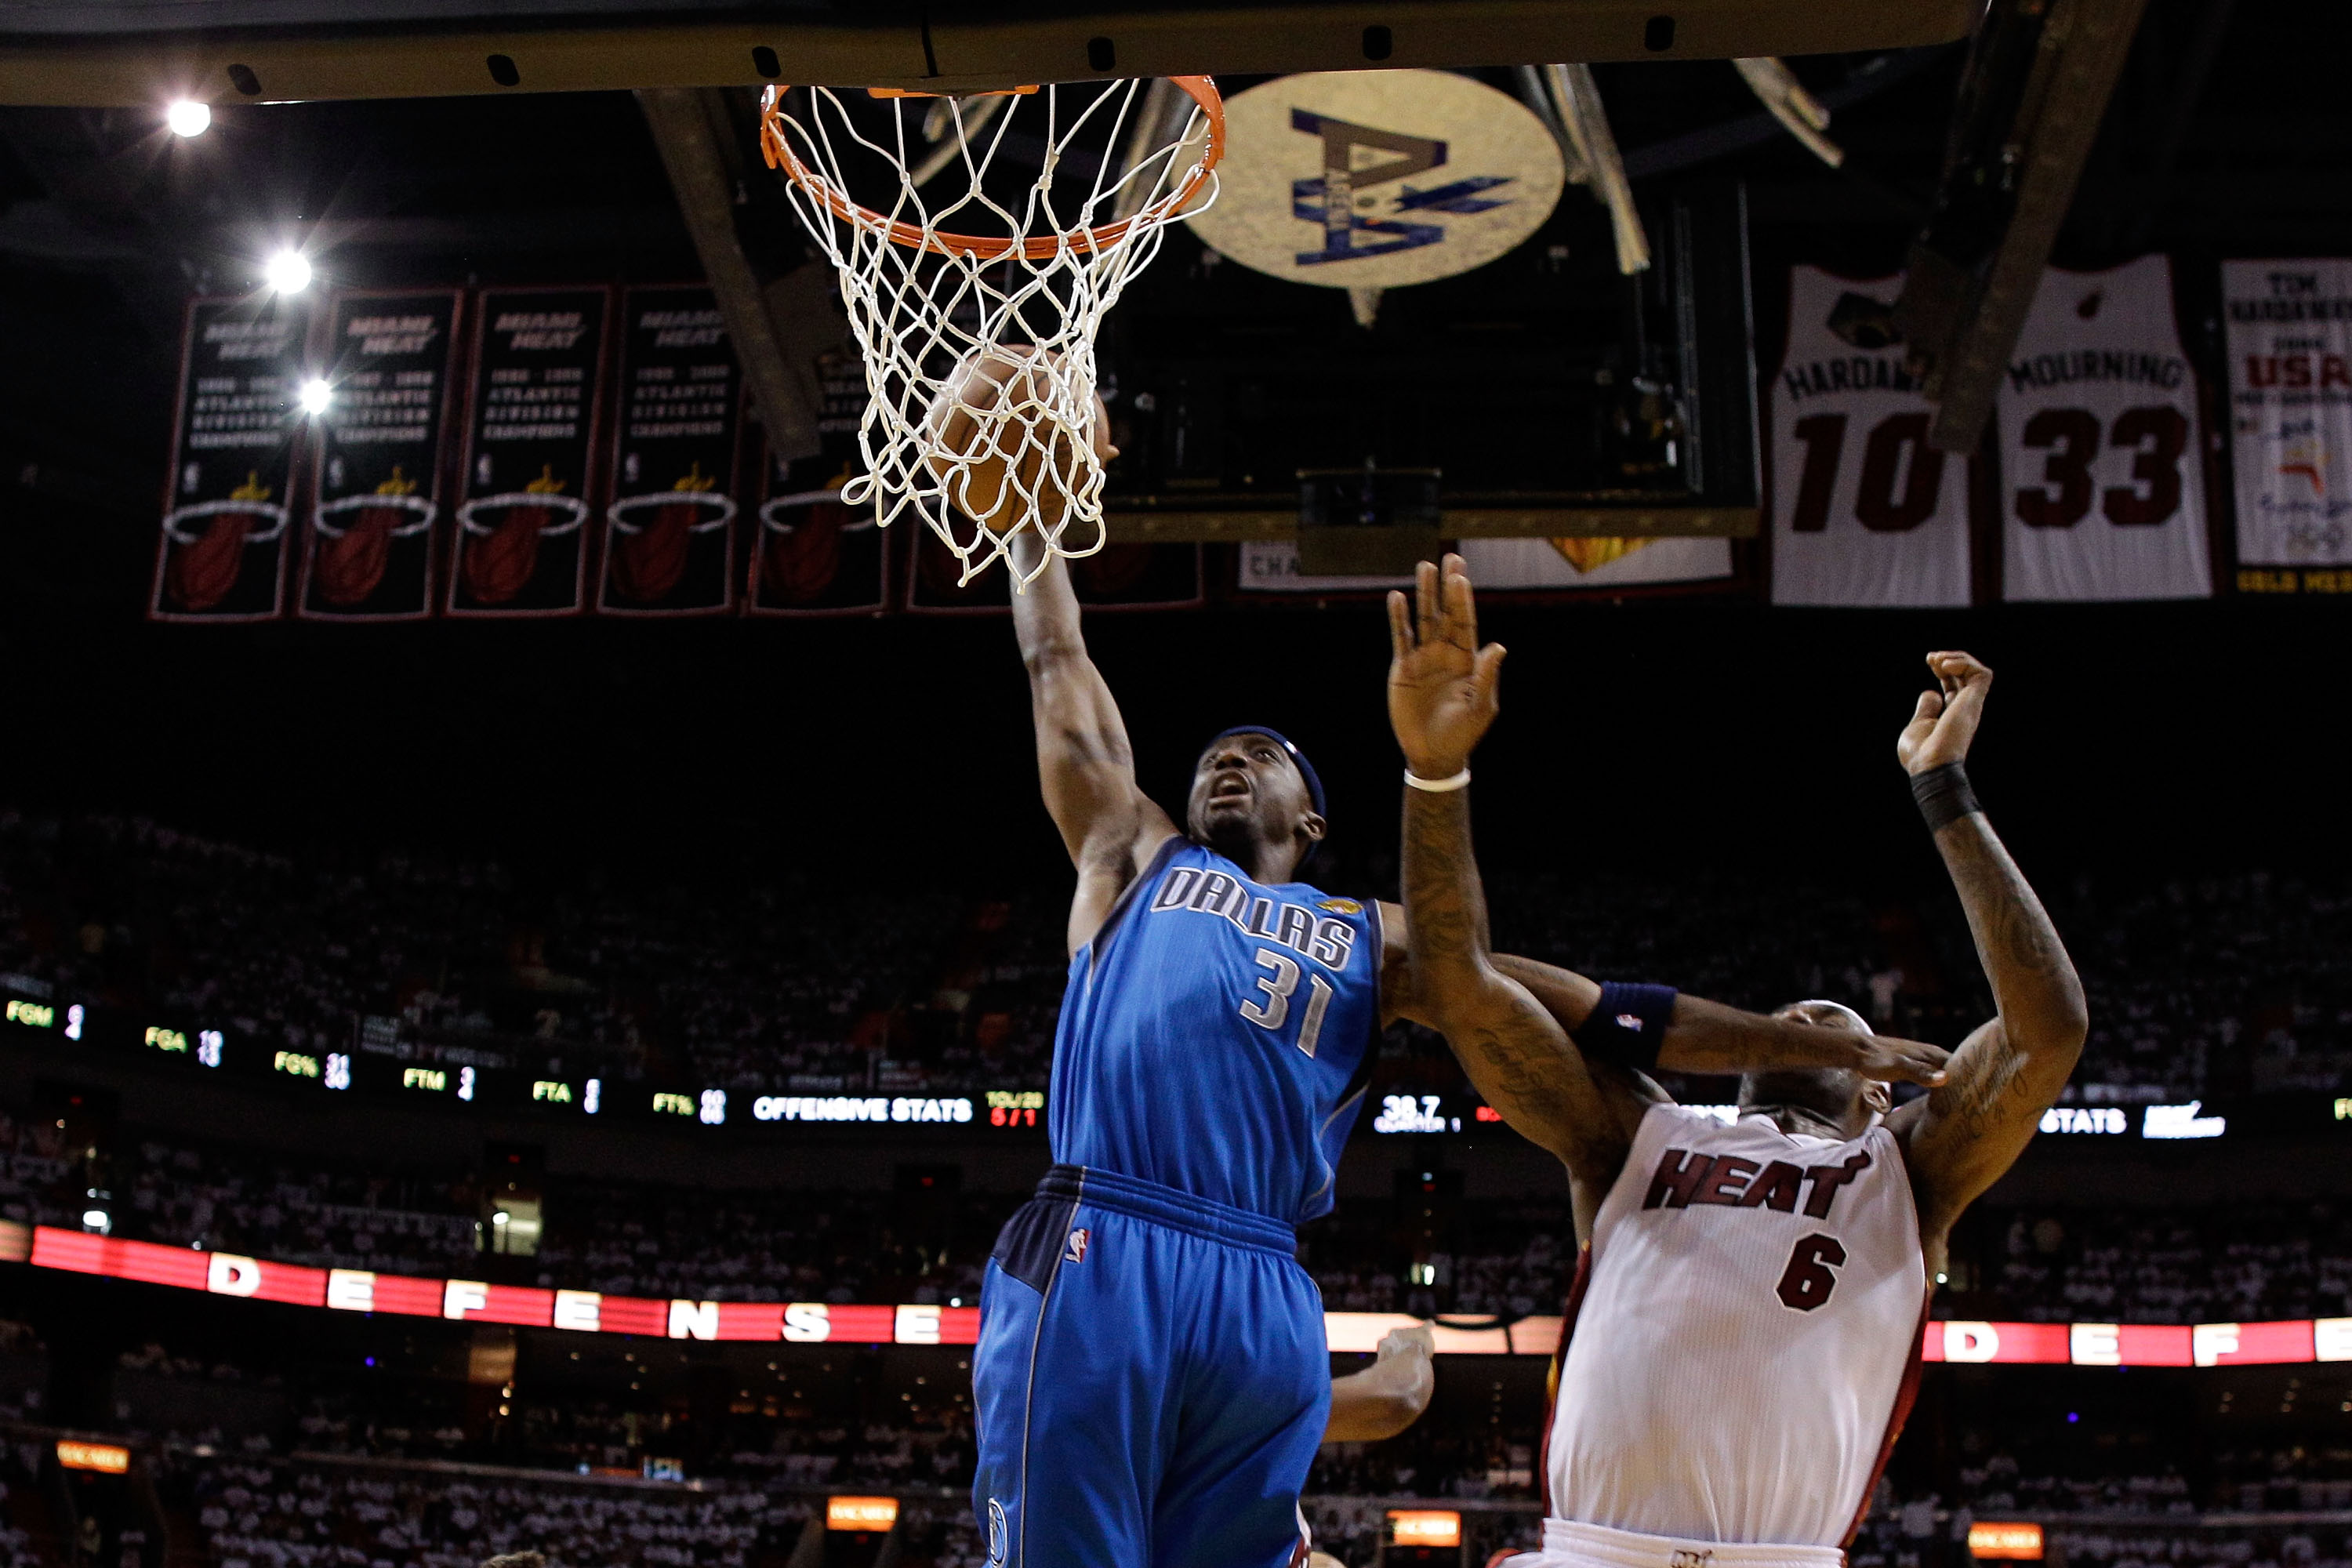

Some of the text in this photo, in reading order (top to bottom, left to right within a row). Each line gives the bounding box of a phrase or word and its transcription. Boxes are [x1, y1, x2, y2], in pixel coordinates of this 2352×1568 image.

[2008, 350, 2184, 392] MOURNING
[2247, 355, 2351, 388] USA
[1793, 412, 1944, 532] 10
[2016, 408, 2189, 528] 33
[1149, 866, 1357, 973] DALLAS
[6, 1000, 54, 1028] FGM
[1238, 946, 1334, 1060] 31
[145, 1026, 189, 1053] FGA
[274, 1051, 319, 1078] FG%
[403, 1068, 447, 1091] FTM
[532, 1080, 572, 1104] FTA
[653, 1093, 695, 1116] FT%
[753, 1096, 975, 1123] OFFENSIVE STATS
[2038, 1106, 2128, 1134] STATS
[1642, 1149, 1871, 1221] HEAT
[1773, 1232, 1848, 1313] 6
